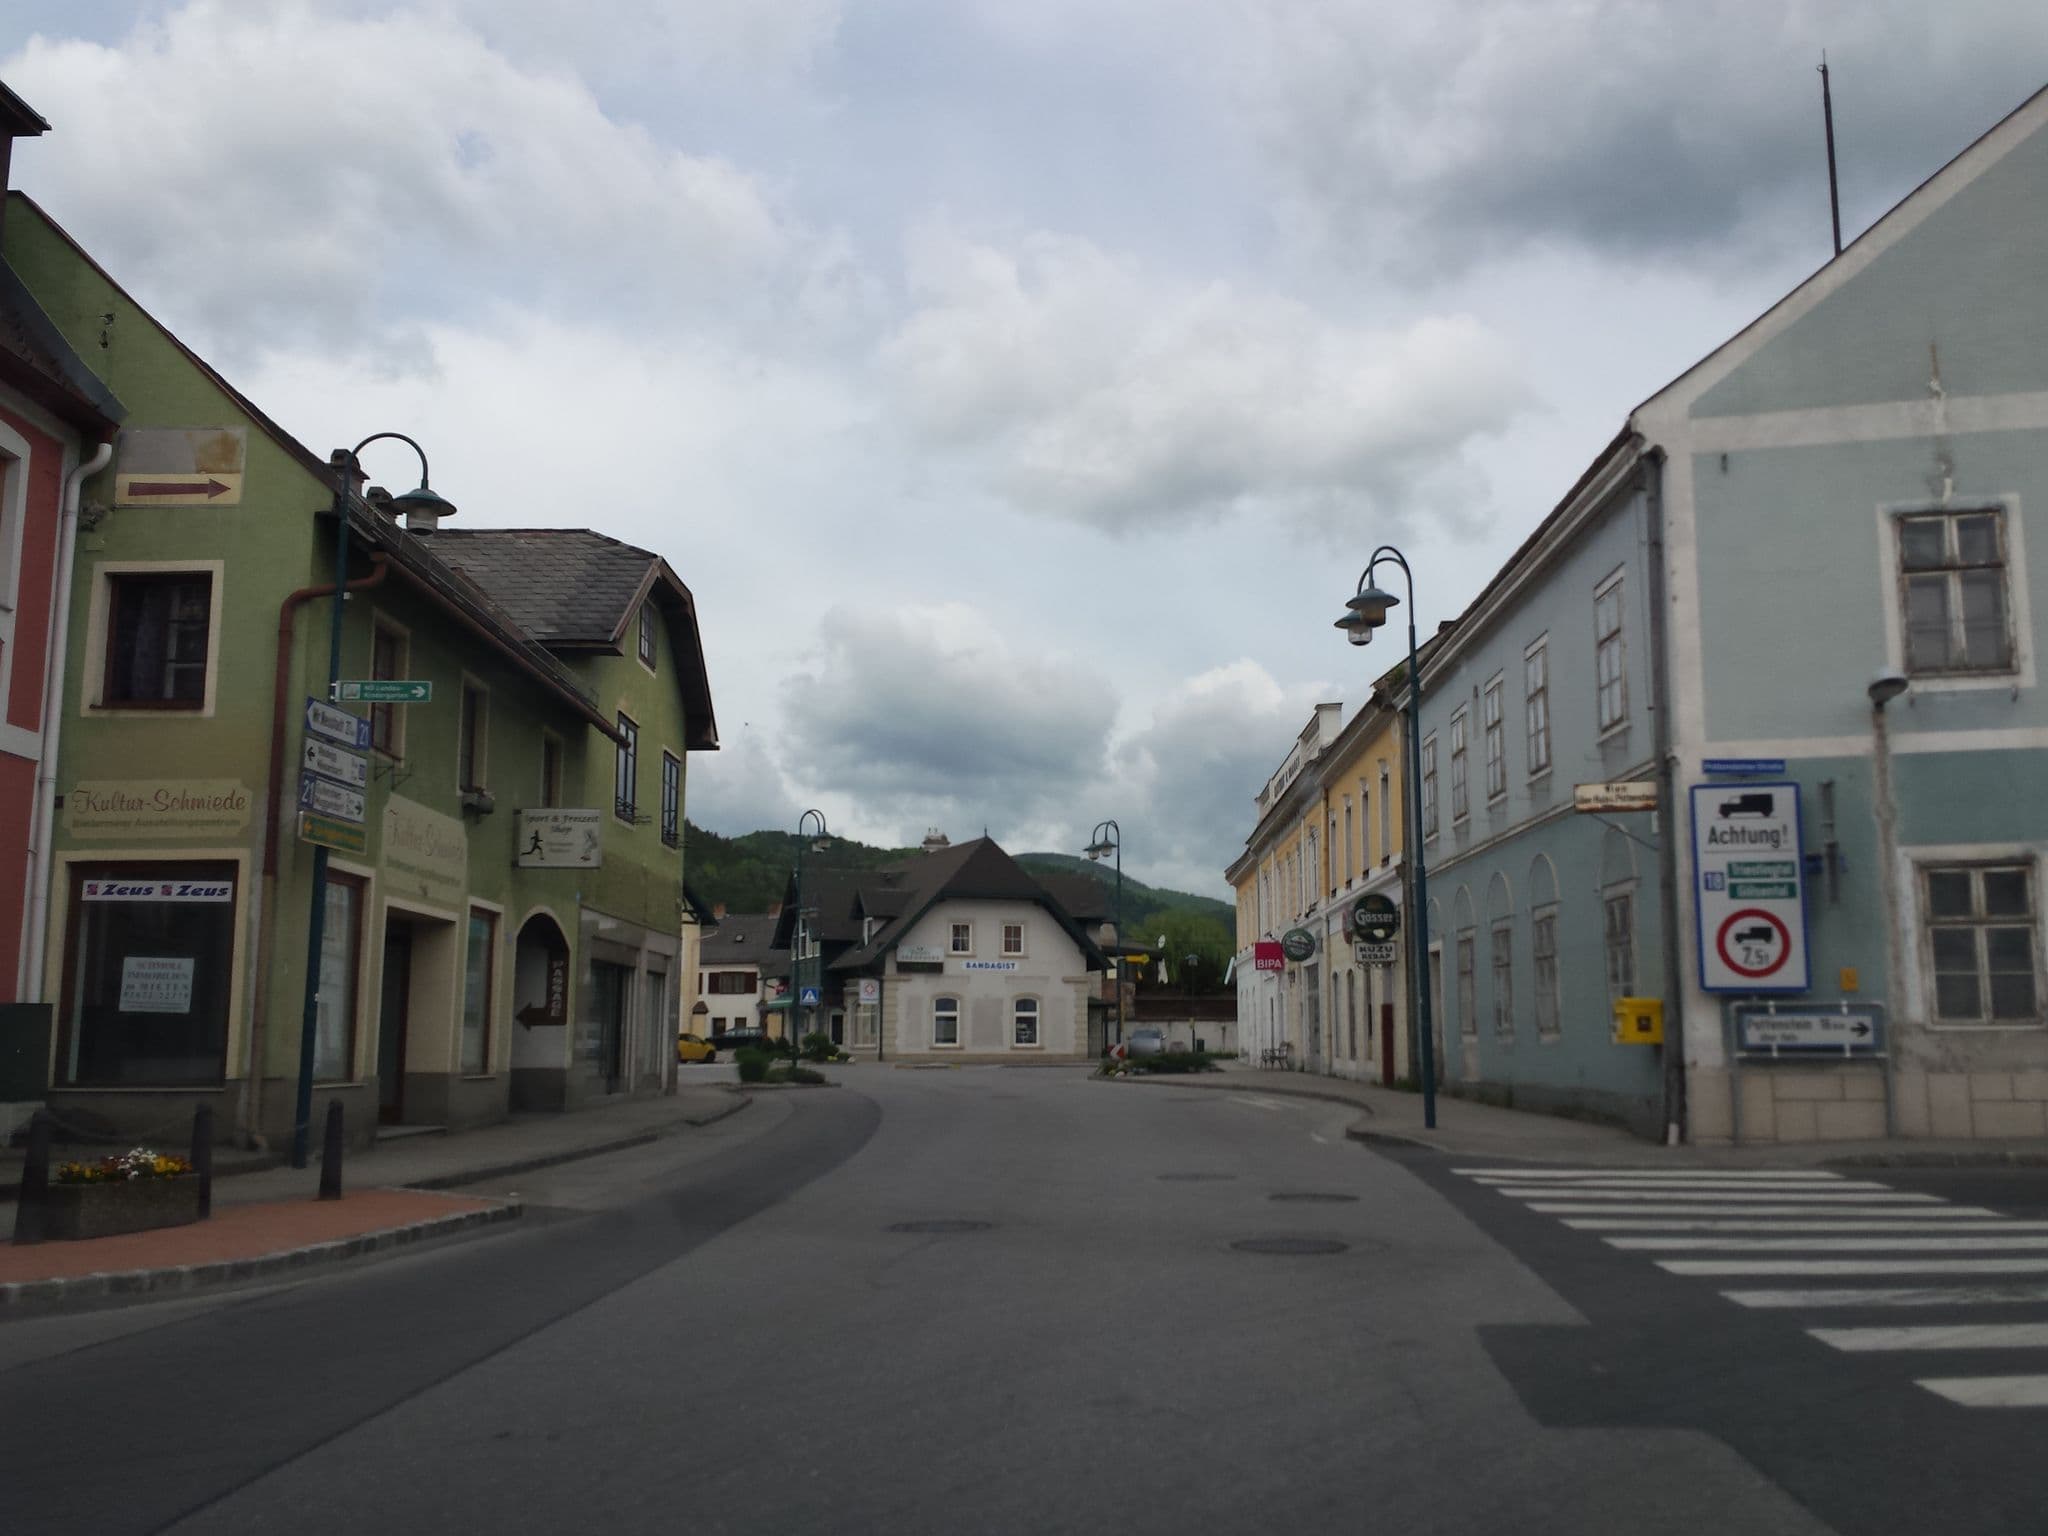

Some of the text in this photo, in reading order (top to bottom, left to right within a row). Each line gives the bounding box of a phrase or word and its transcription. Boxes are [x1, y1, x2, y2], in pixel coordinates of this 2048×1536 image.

[72, 788, 247, 816] Kultur-Schmiede
[1708, 823, 1788, 849] Achtung!
[101, 884, 230, 897] Zeus Zeus
[965, 961, 1016, 970] BANDAGIST
[1256, 958, 1283, 970] BIPA
